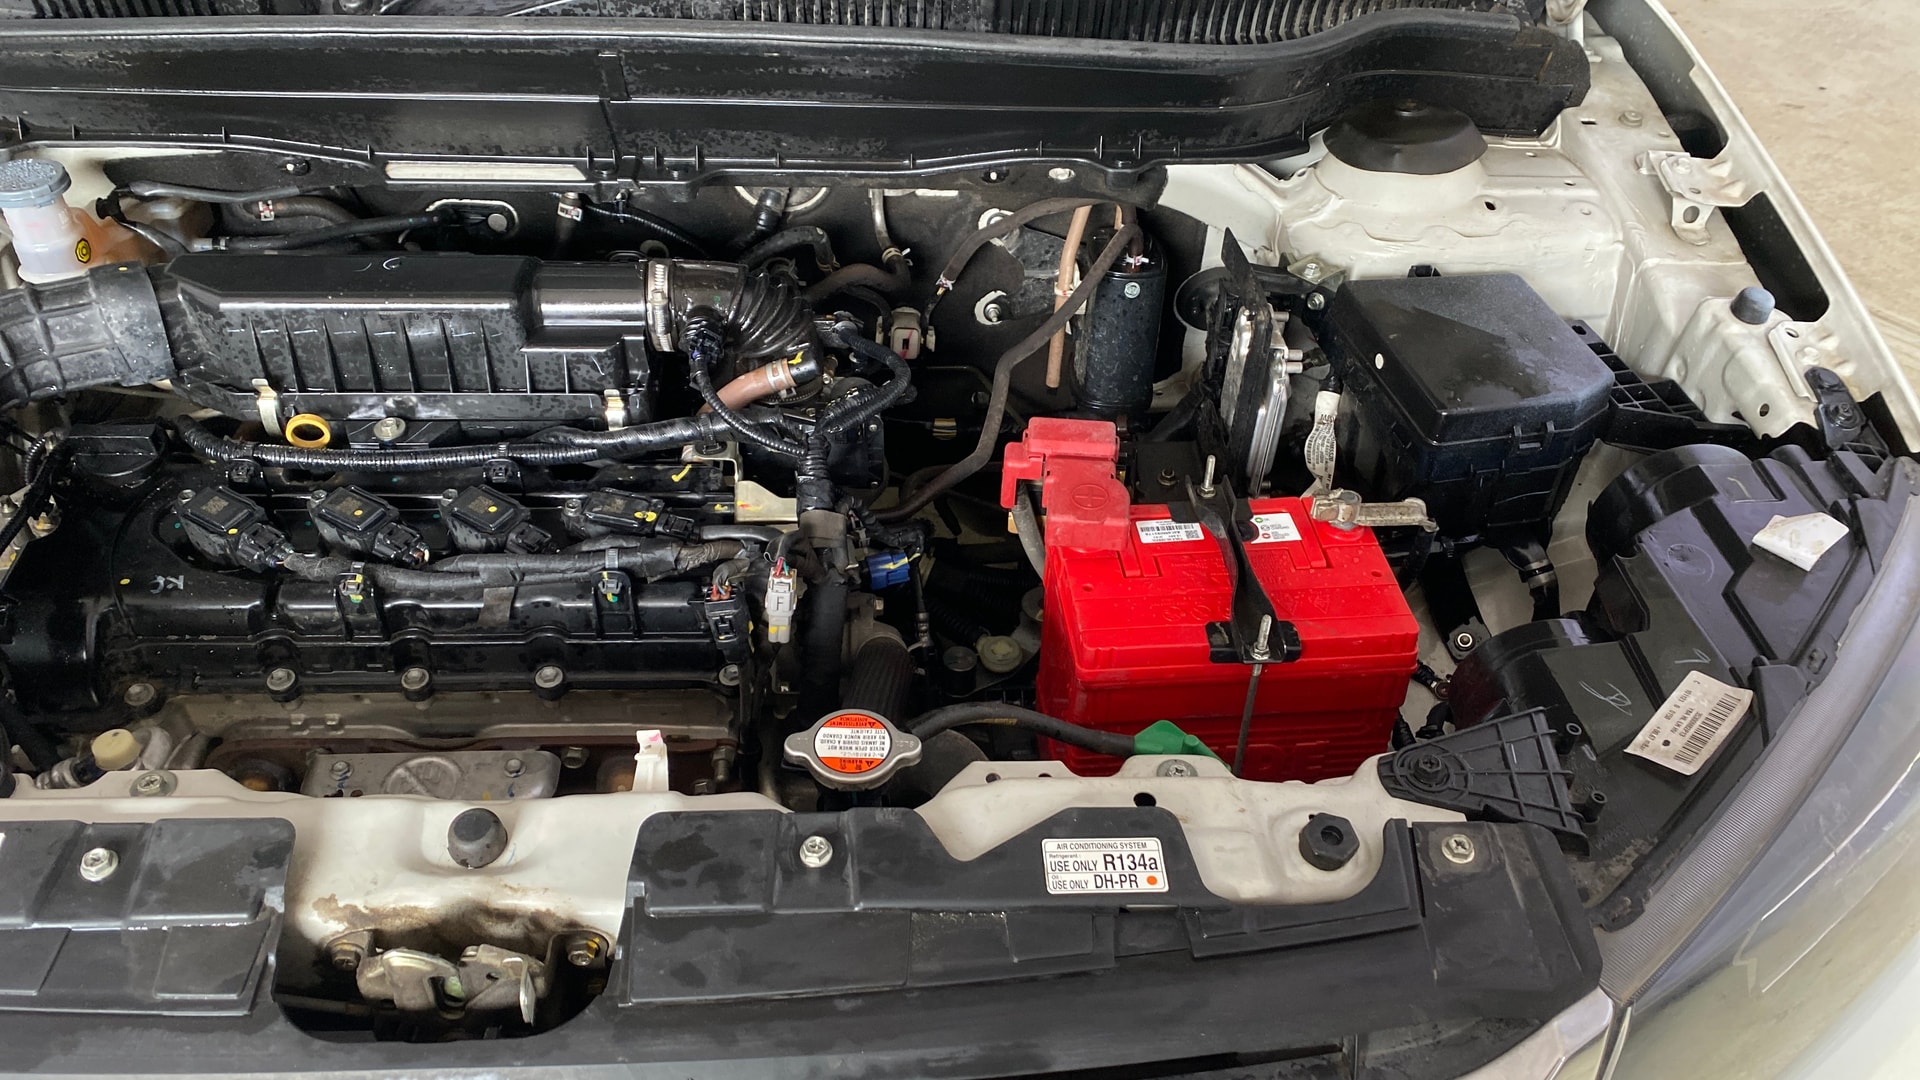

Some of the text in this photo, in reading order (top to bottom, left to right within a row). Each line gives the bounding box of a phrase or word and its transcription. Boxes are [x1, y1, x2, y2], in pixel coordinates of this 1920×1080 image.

[1057, 841, 1148, 850] AIR CONDITIONING SYSTEM
[1049, 853, 1159, 872] USE ONLY R134a
[1052, 874, 1139, 890] USE ONLY DH-PR
